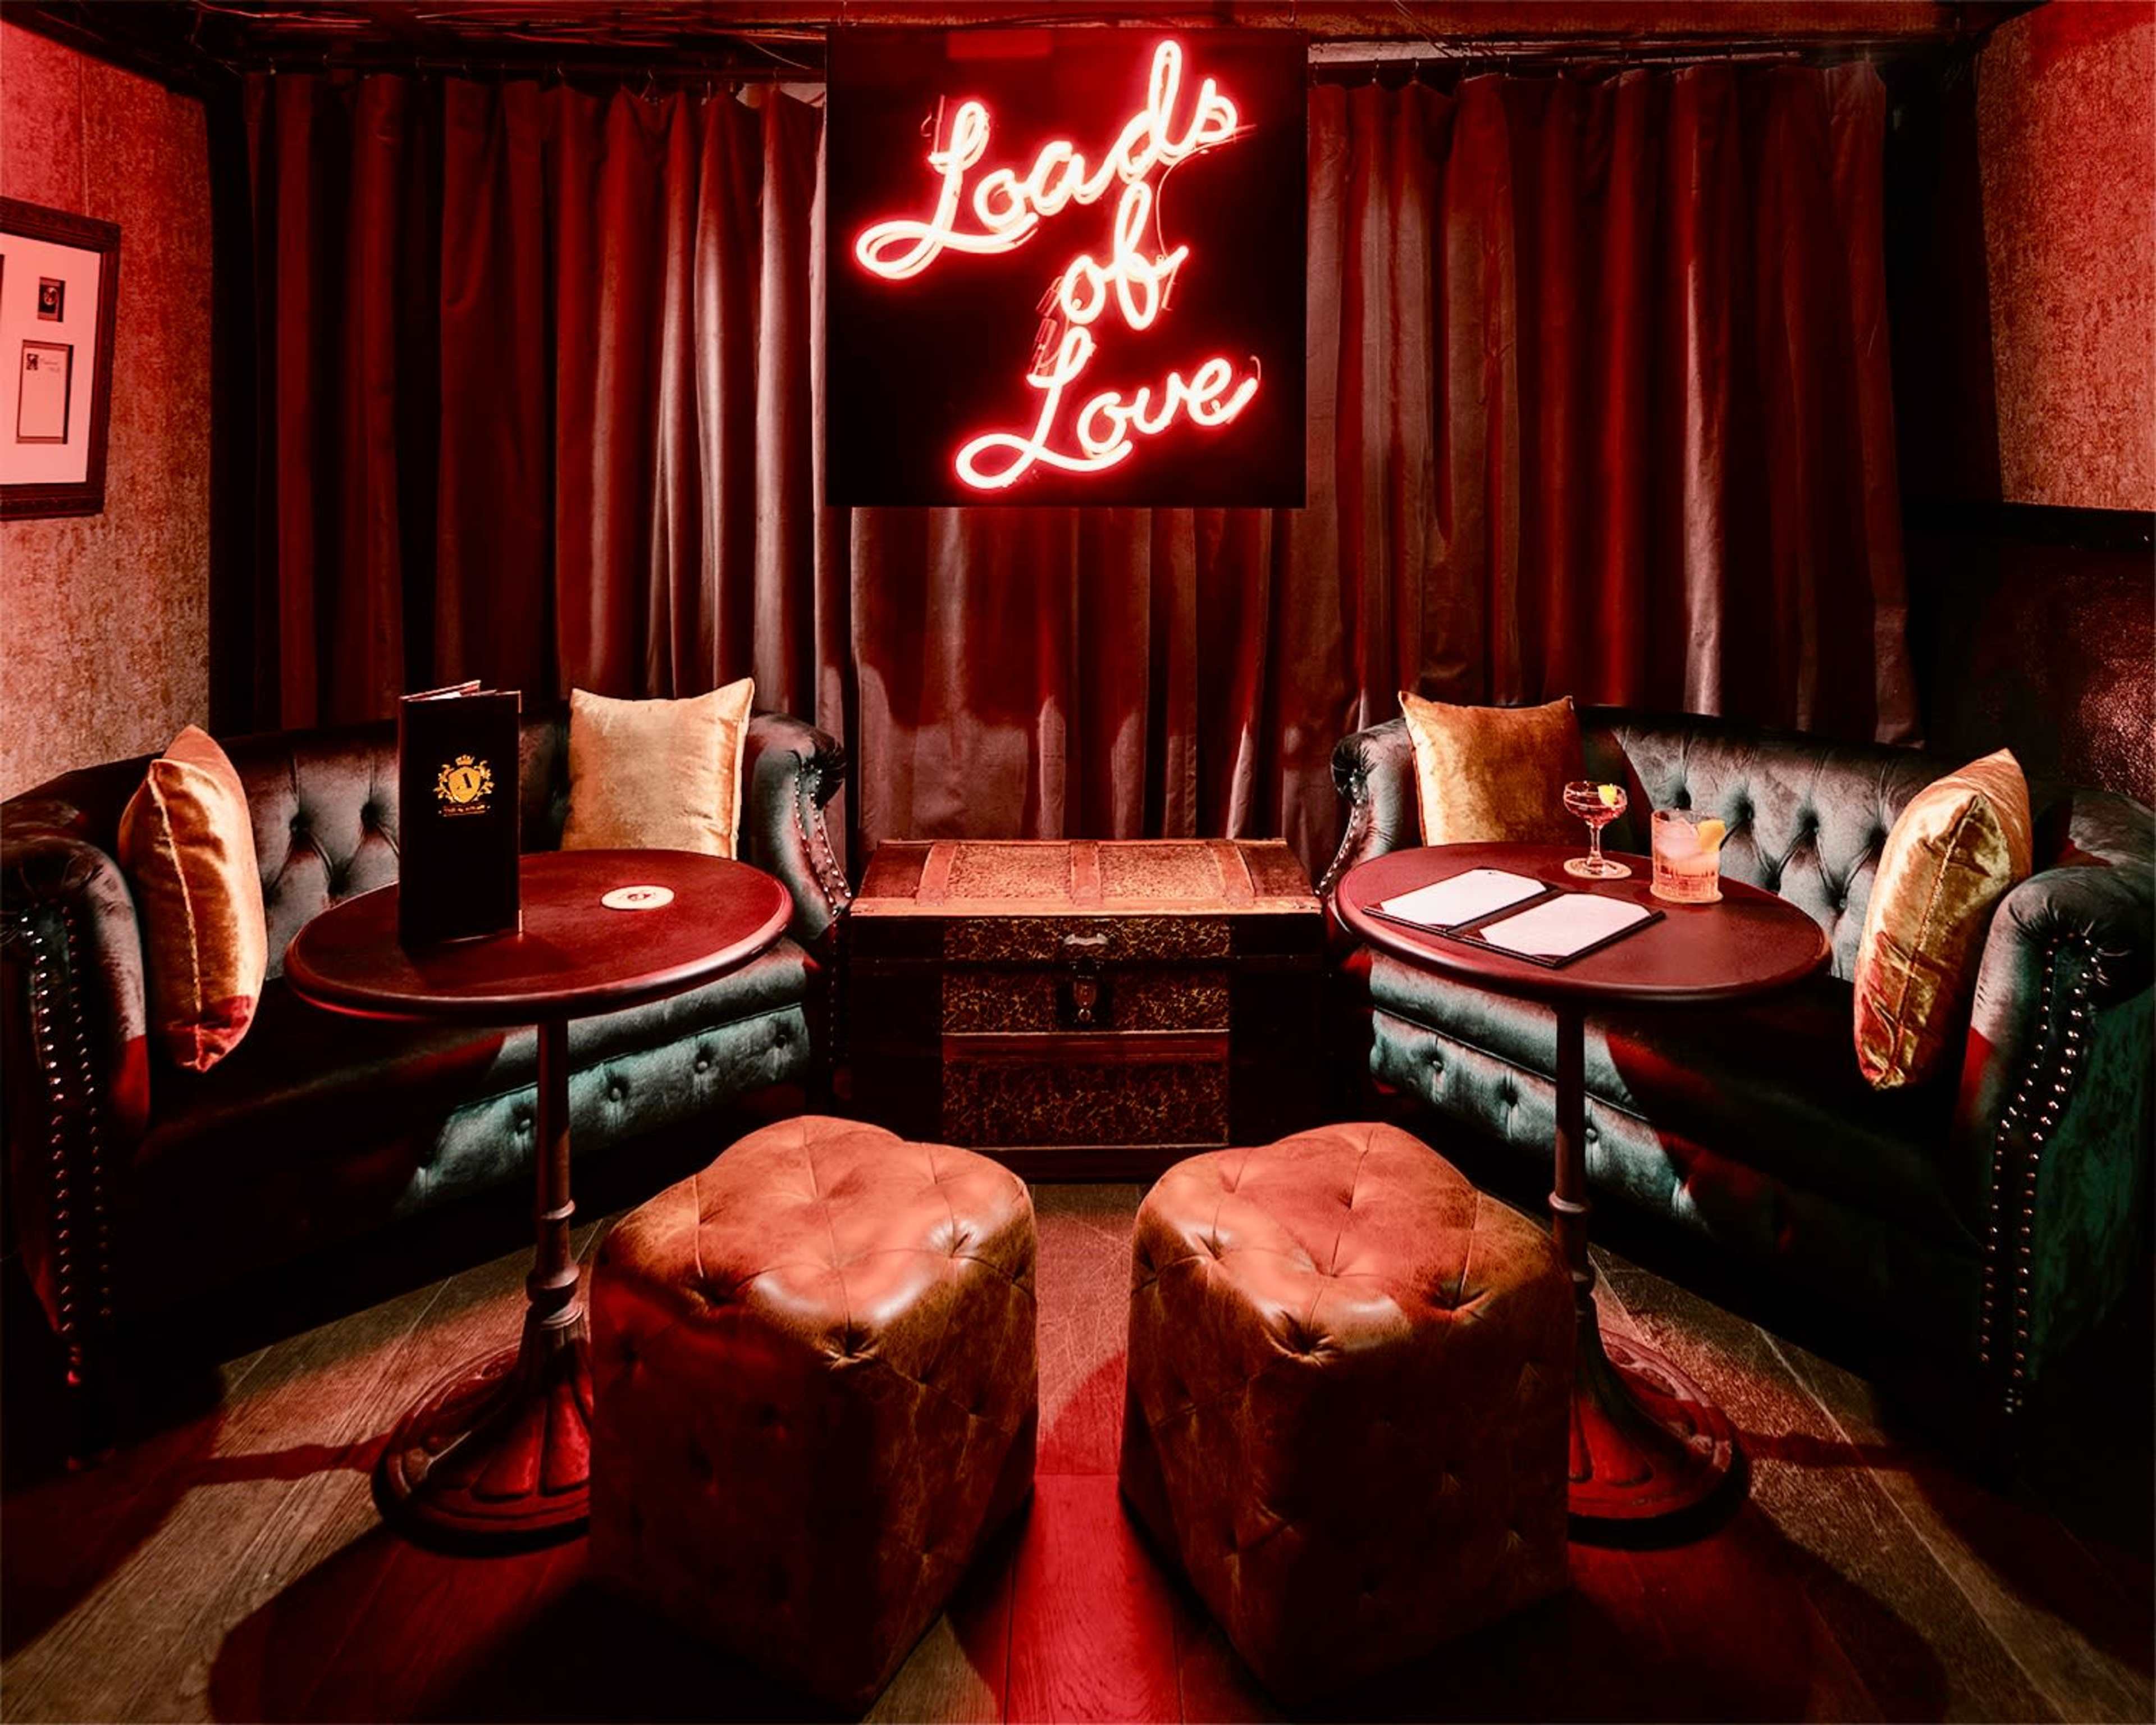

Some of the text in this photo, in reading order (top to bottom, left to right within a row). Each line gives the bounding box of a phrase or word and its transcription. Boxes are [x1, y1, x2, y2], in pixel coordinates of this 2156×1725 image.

[856, 40, 1239, 279] Loads
[1059, 181, 1188, 330] of
[956, 327, 1258, 489] Love
